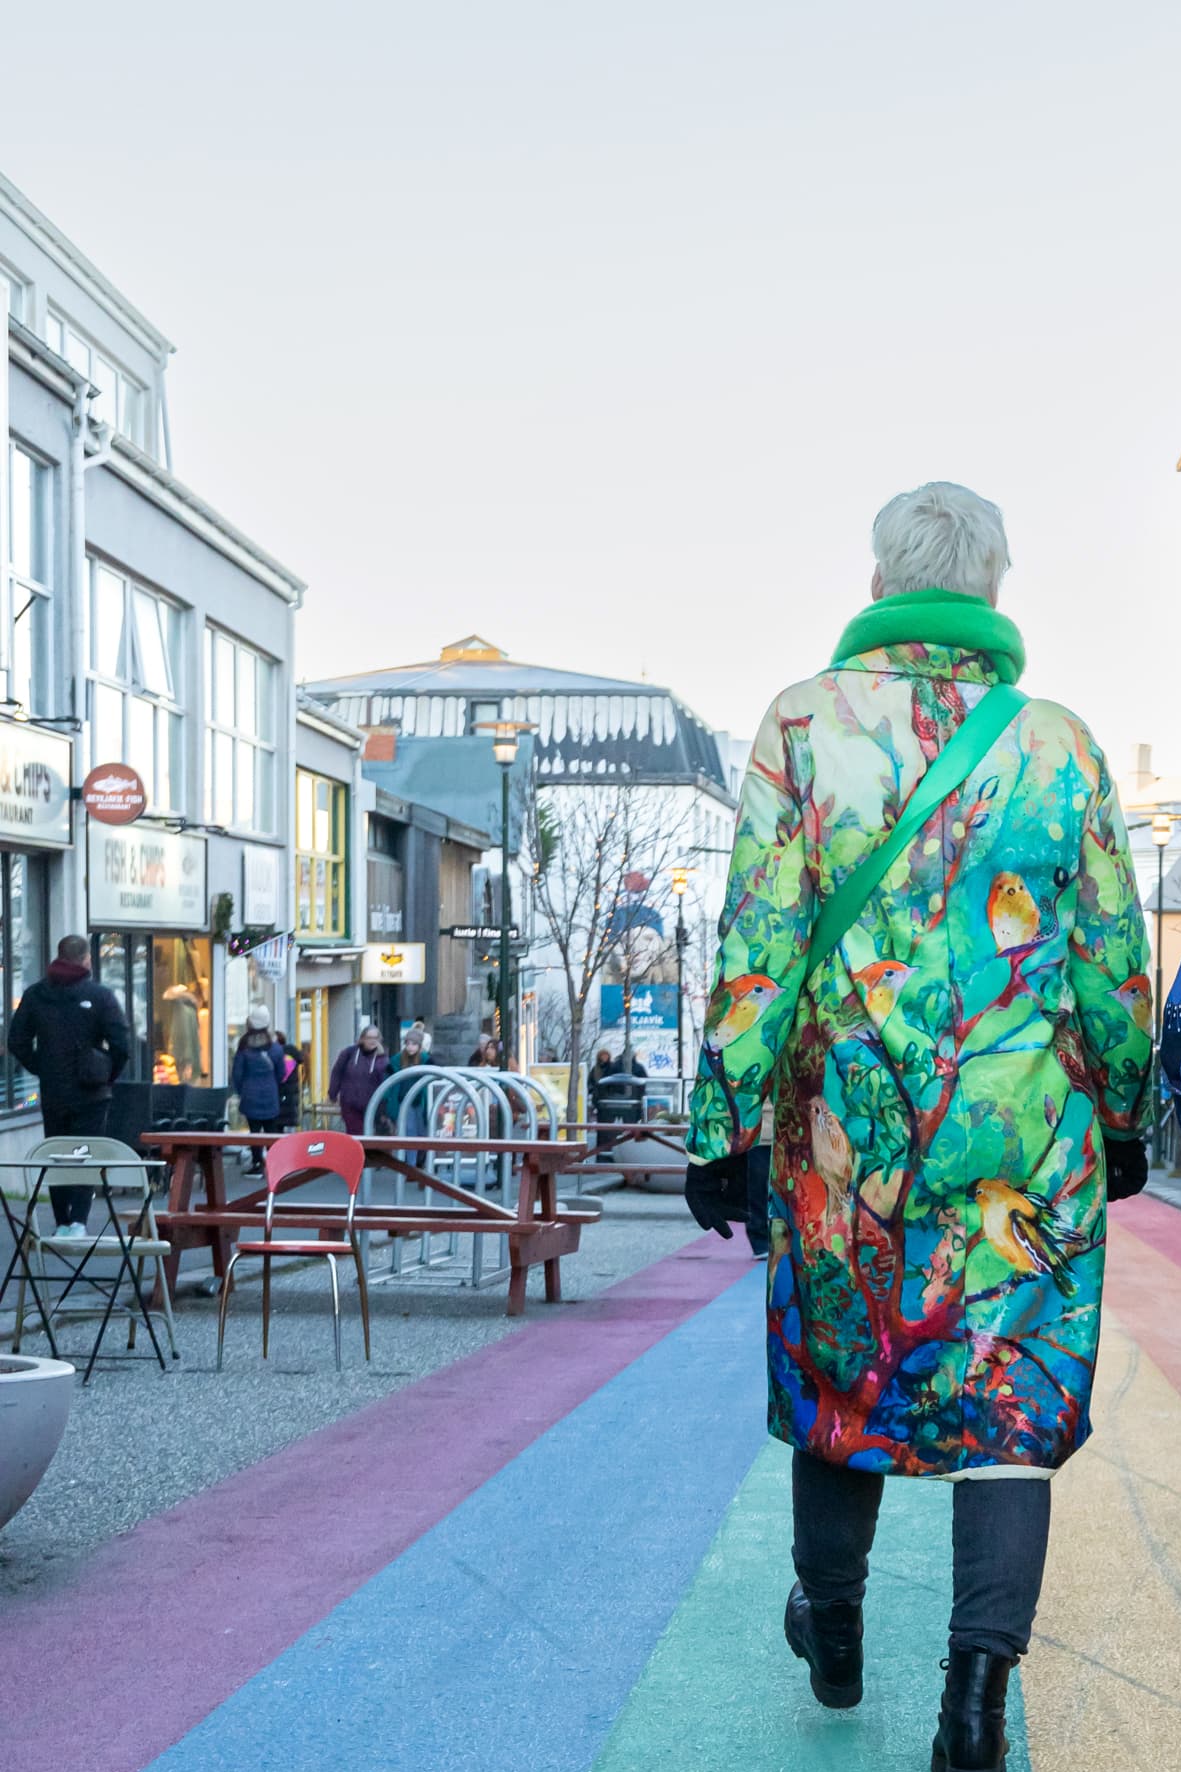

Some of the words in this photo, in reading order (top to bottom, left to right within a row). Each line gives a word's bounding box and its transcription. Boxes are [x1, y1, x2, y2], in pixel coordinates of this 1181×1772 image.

[14, 761, 51, 803] CHIPS
[104, 839, 126, 884] FISH
[130, 845, 138, 884] &
[141, 844, 165, 888] CHIPS
[120, 892, 152, 908] RESTAURANT
